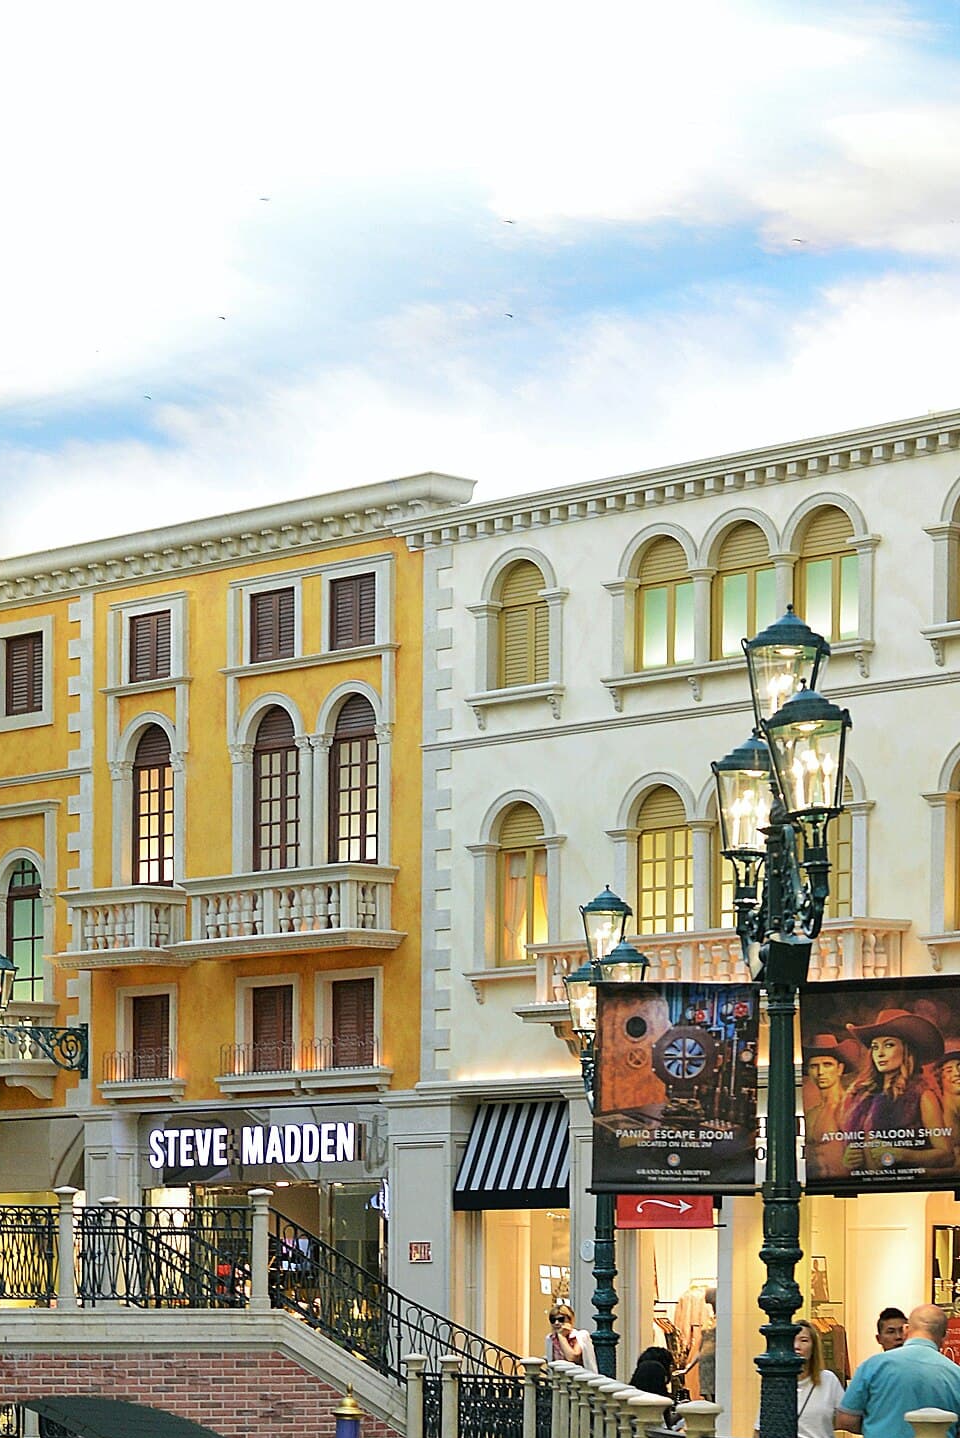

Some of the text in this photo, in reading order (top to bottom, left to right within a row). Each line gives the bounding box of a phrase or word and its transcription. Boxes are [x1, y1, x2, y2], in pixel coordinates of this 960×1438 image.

[615, 1130, 734, 1140] PANIQ ESCAPE ROOM
[822, 1127, 952, 1142] ATOMIC SALOON SHOW
[149, 1122, 355, 1169] STEVE MADDEN
